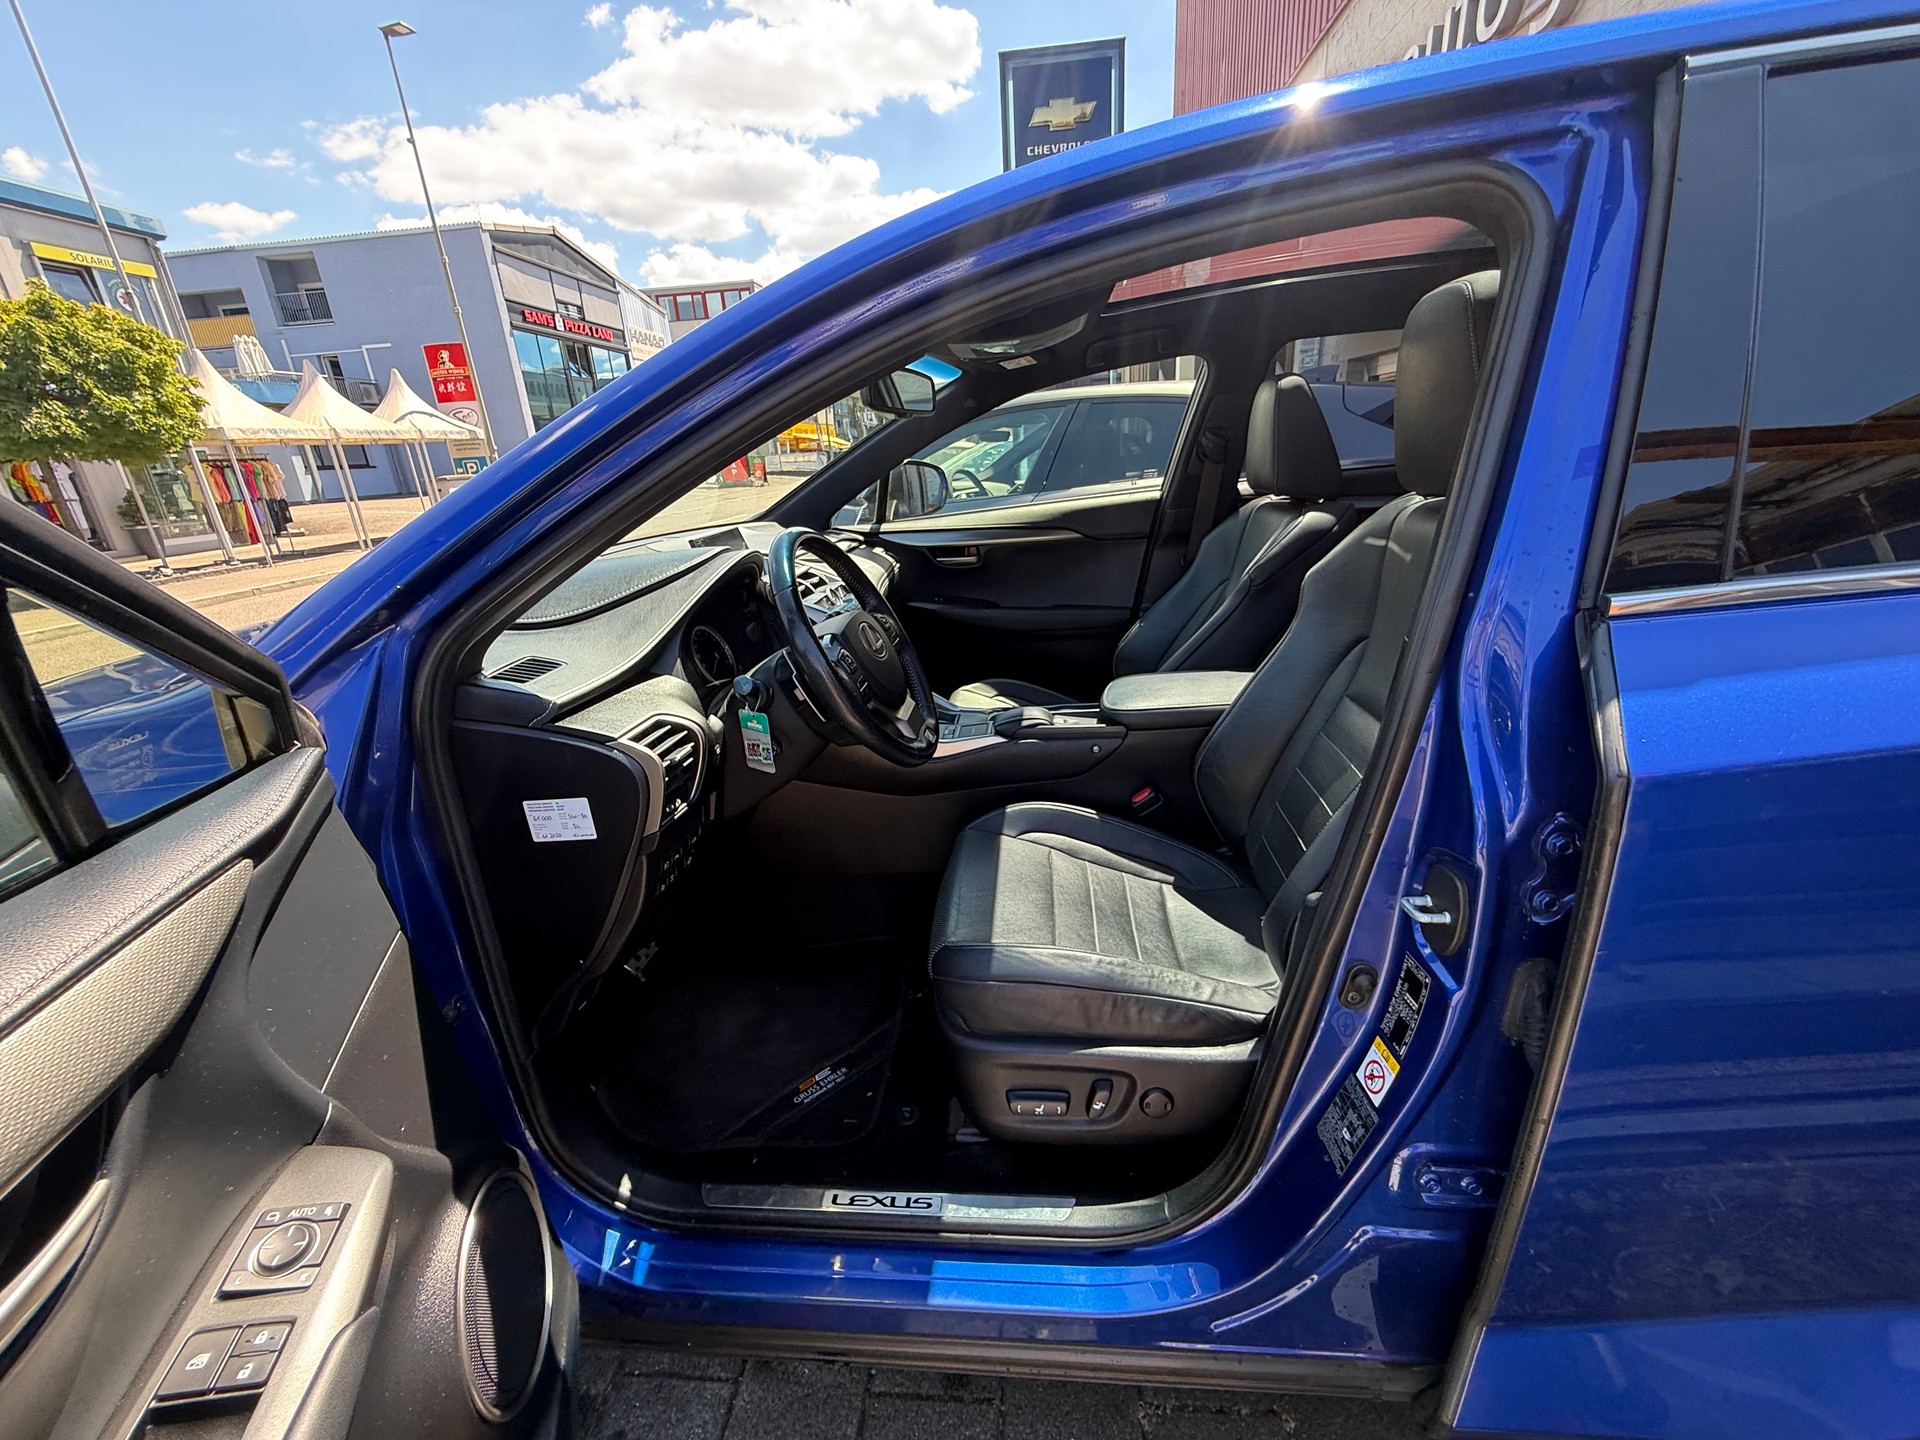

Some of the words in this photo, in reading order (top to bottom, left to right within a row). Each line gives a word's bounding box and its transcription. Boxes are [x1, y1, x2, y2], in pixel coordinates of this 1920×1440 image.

[523, 309, 554, 327] SAM'S
[564, 318, 591, 336] PIZZA
[591, 326, 614, 342] LAND
[793, 1084, 820, 1103] GRUSS
[819, 1067, 848, 1087] EHRLER
[287, 1207, 317, 1218] AUTO
[831, 1193, 933, 1210] LEXUS
